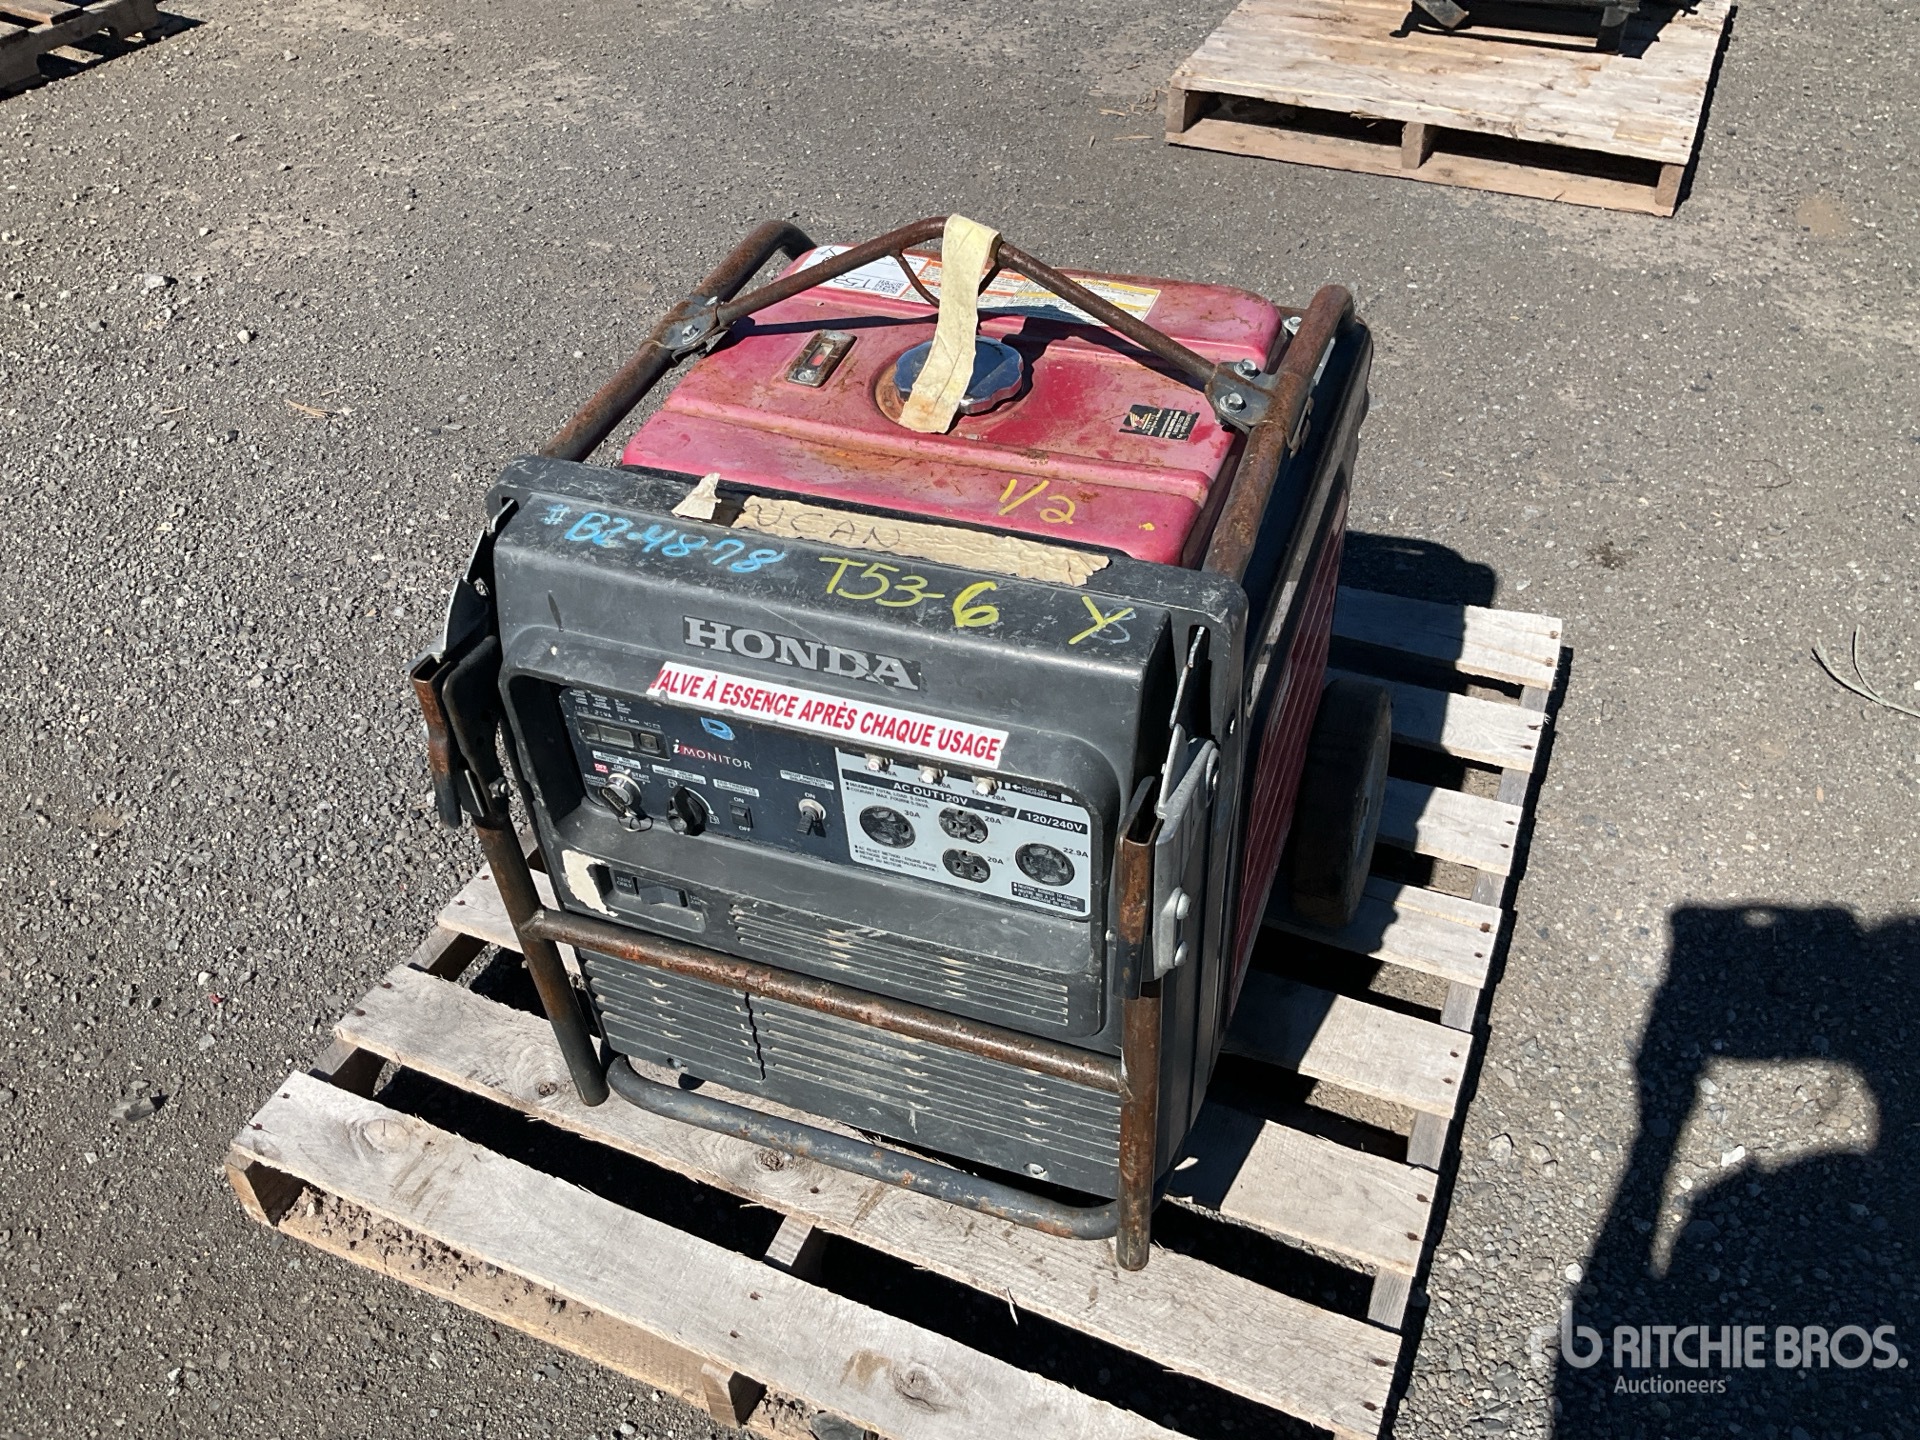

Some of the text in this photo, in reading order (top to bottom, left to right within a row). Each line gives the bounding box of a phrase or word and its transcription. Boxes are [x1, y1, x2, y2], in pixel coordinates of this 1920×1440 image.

[999, 479, 1076, 524] 1/2
[684, 616, 918, 690] HONDA
[703, 674, 717, 700] À
[719, 682, 799, 718] ESSENCE
[799, 700, 857, 730] APRÈS
[860, 714, 941, 747] CHAQUE
[938, 729, 1000, 761] USAGE
[893, 783, 911, 792] AC
[804, 791, 816, 799] ON
[903, 809, 921, 818] 30A
[984, 815, 1001, 825] 20A
[1025, 812, 1083, 832] 120/240V
[1062, 847, 1089, 858] 22.9A
[987, 856, 1004, 865] 20A
